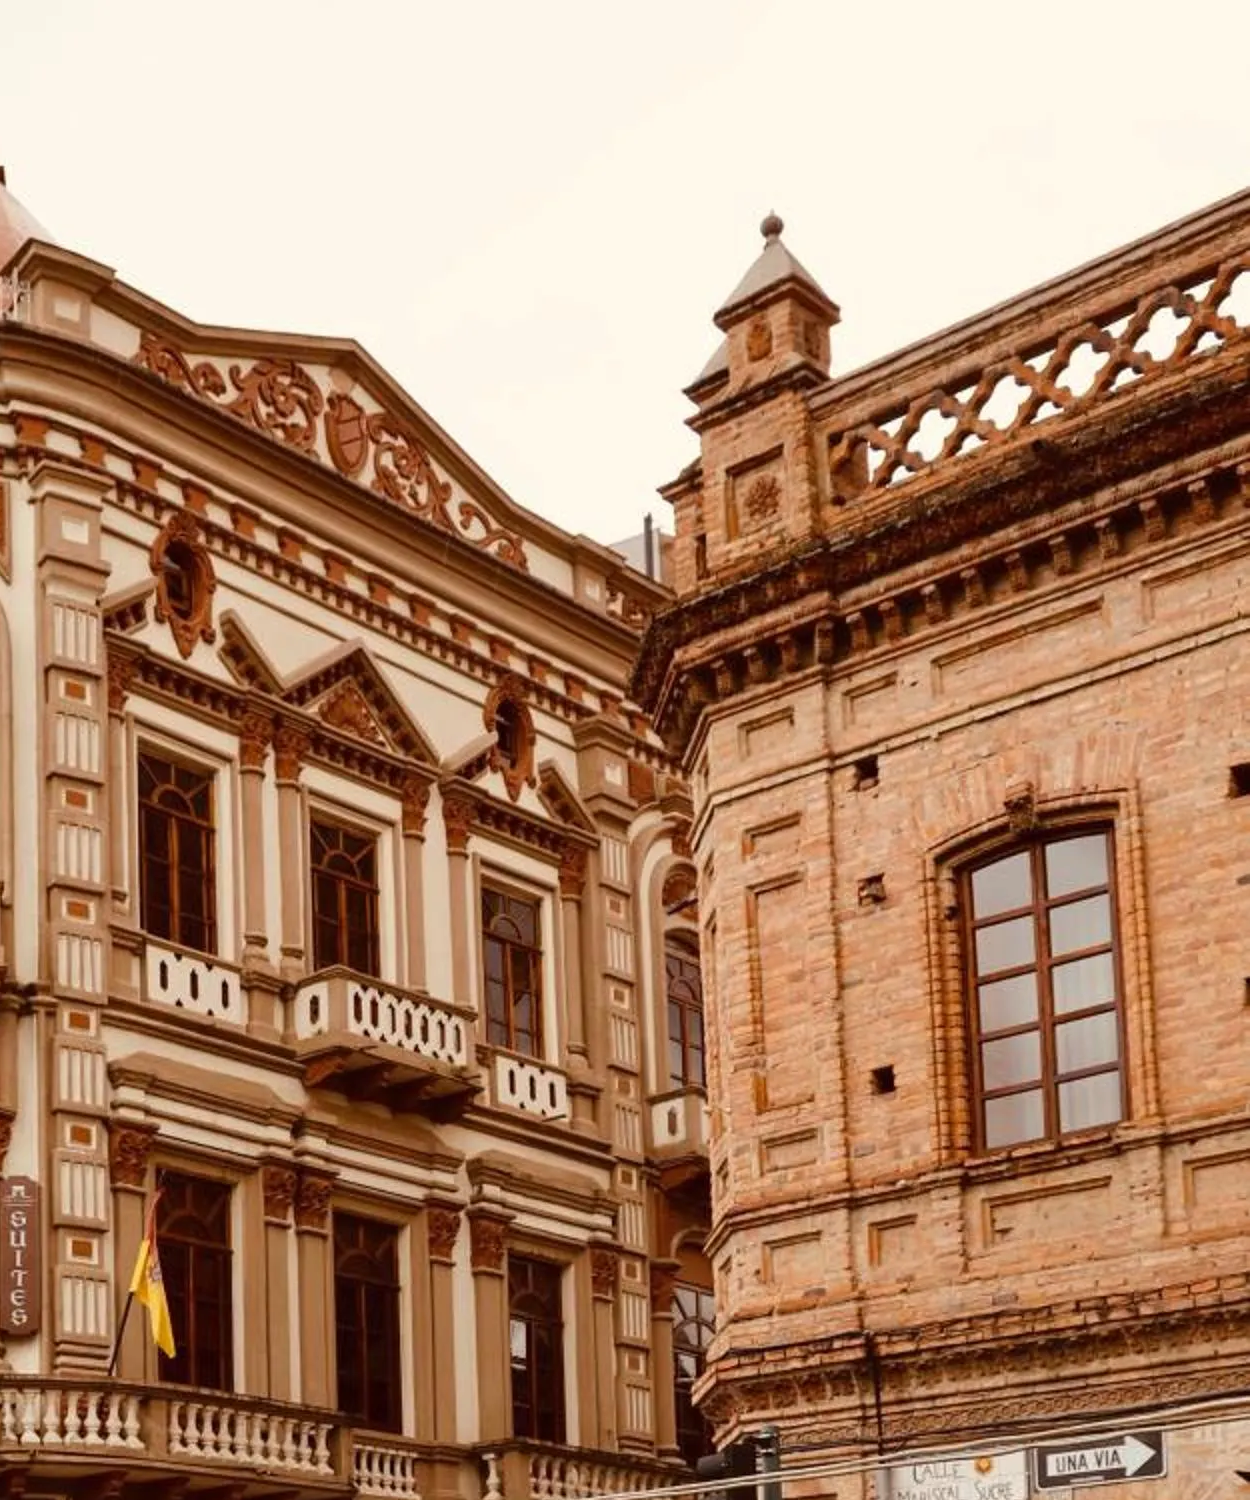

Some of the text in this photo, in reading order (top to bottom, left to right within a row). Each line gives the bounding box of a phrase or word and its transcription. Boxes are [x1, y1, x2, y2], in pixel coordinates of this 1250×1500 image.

[9, 1210, 28, 1326] SUITES
[912, 1461, 967, 1484] CALLE
[1055, 1448, 1123, 1473] UNA VIA
